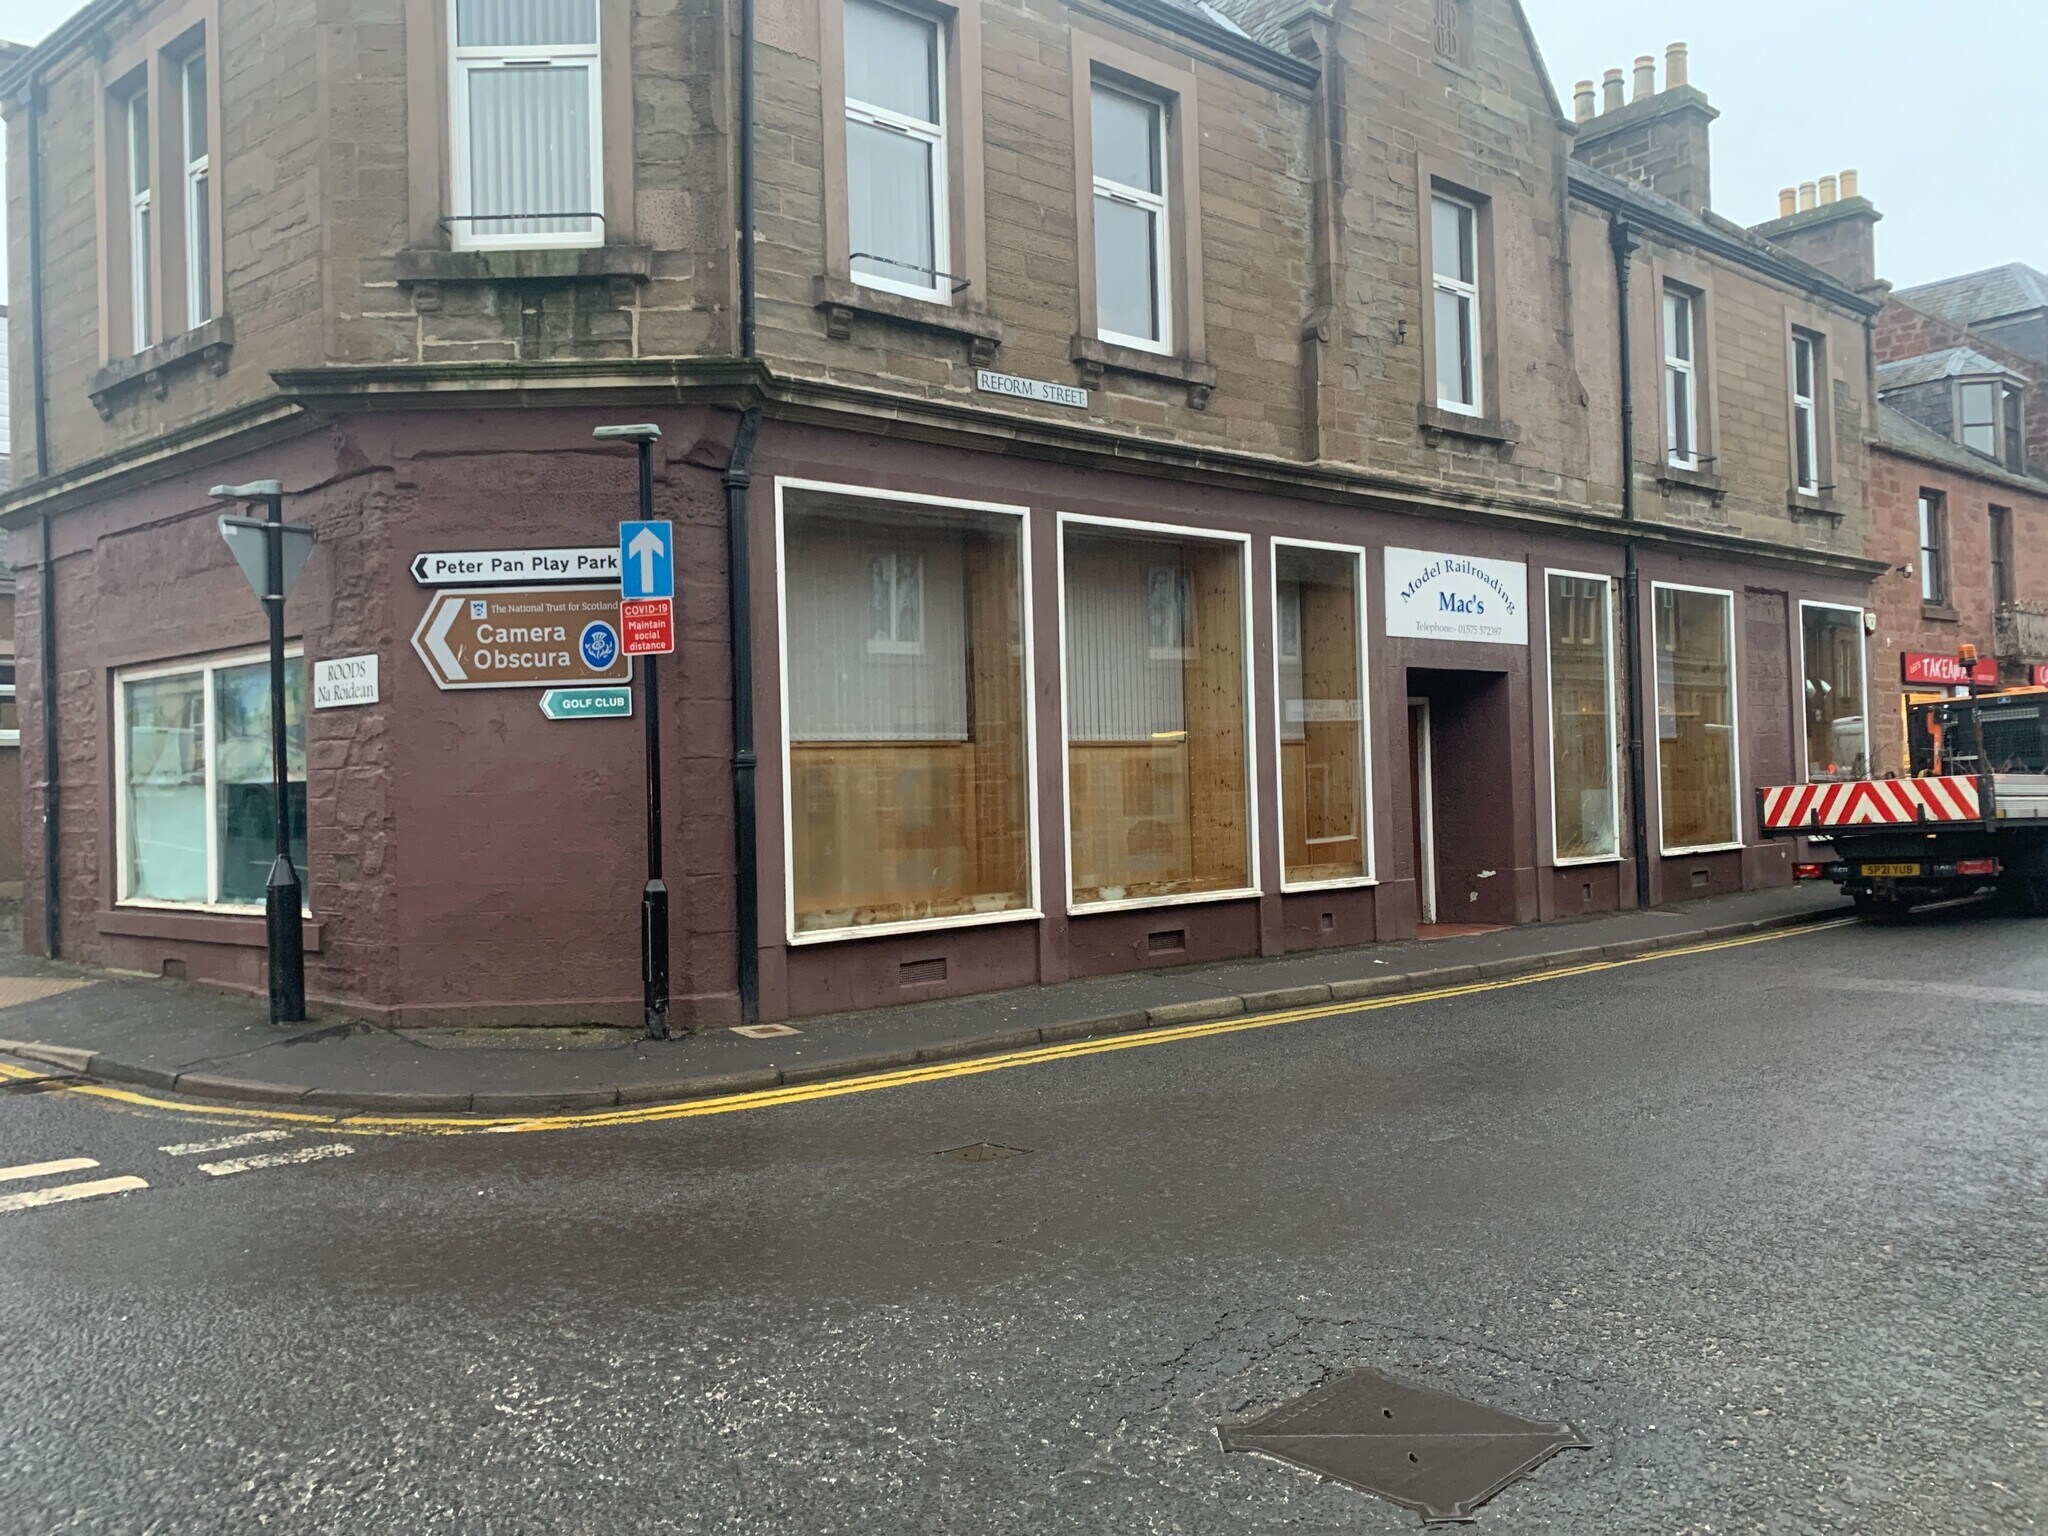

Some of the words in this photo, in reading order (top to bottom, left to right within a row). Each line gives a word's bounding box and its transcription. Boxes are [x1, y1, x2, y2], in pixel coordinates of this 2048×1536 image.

[981, 374, 1033, 396] REFORM
[1042, 385, 1084, 405] STREET
[436, 560, 483, 574] Peter
[491, 558, 524, 572] Pan
[532, 557, 570, 573] Play
[577, 555, 618, 570] Park
[1400, 561, 1441, 604] Model
[1444, 559, 1516, 616] Railroading
[491, 604, 507, 614] The
[508, 603, 544, 613] National
[545, 603, 567, 612] Trust
[568, 602, 580, 611] for
[581, 601, 619, 610] Scotland
[625, 603, 668, 615] COVID-19
[1438, 591, 1485, 615] Mac's
[628, 620, 666, 630] Maintain
[476, 624, 567, 644] Camera
[634, 630, 660, 641] social
[629, 641, 666, 651] distance
[474, 649, 571, 669] Obscura
[328, 661, 366, 681] ROODS
[318, 686, 331, 703] Na
[562, 699, 592, 709] GOLF
[595, 697, 625, 708] CLUB
[1867, 865, 1890, 875] SP21
[1893, 864, 1913, 874] YUB
